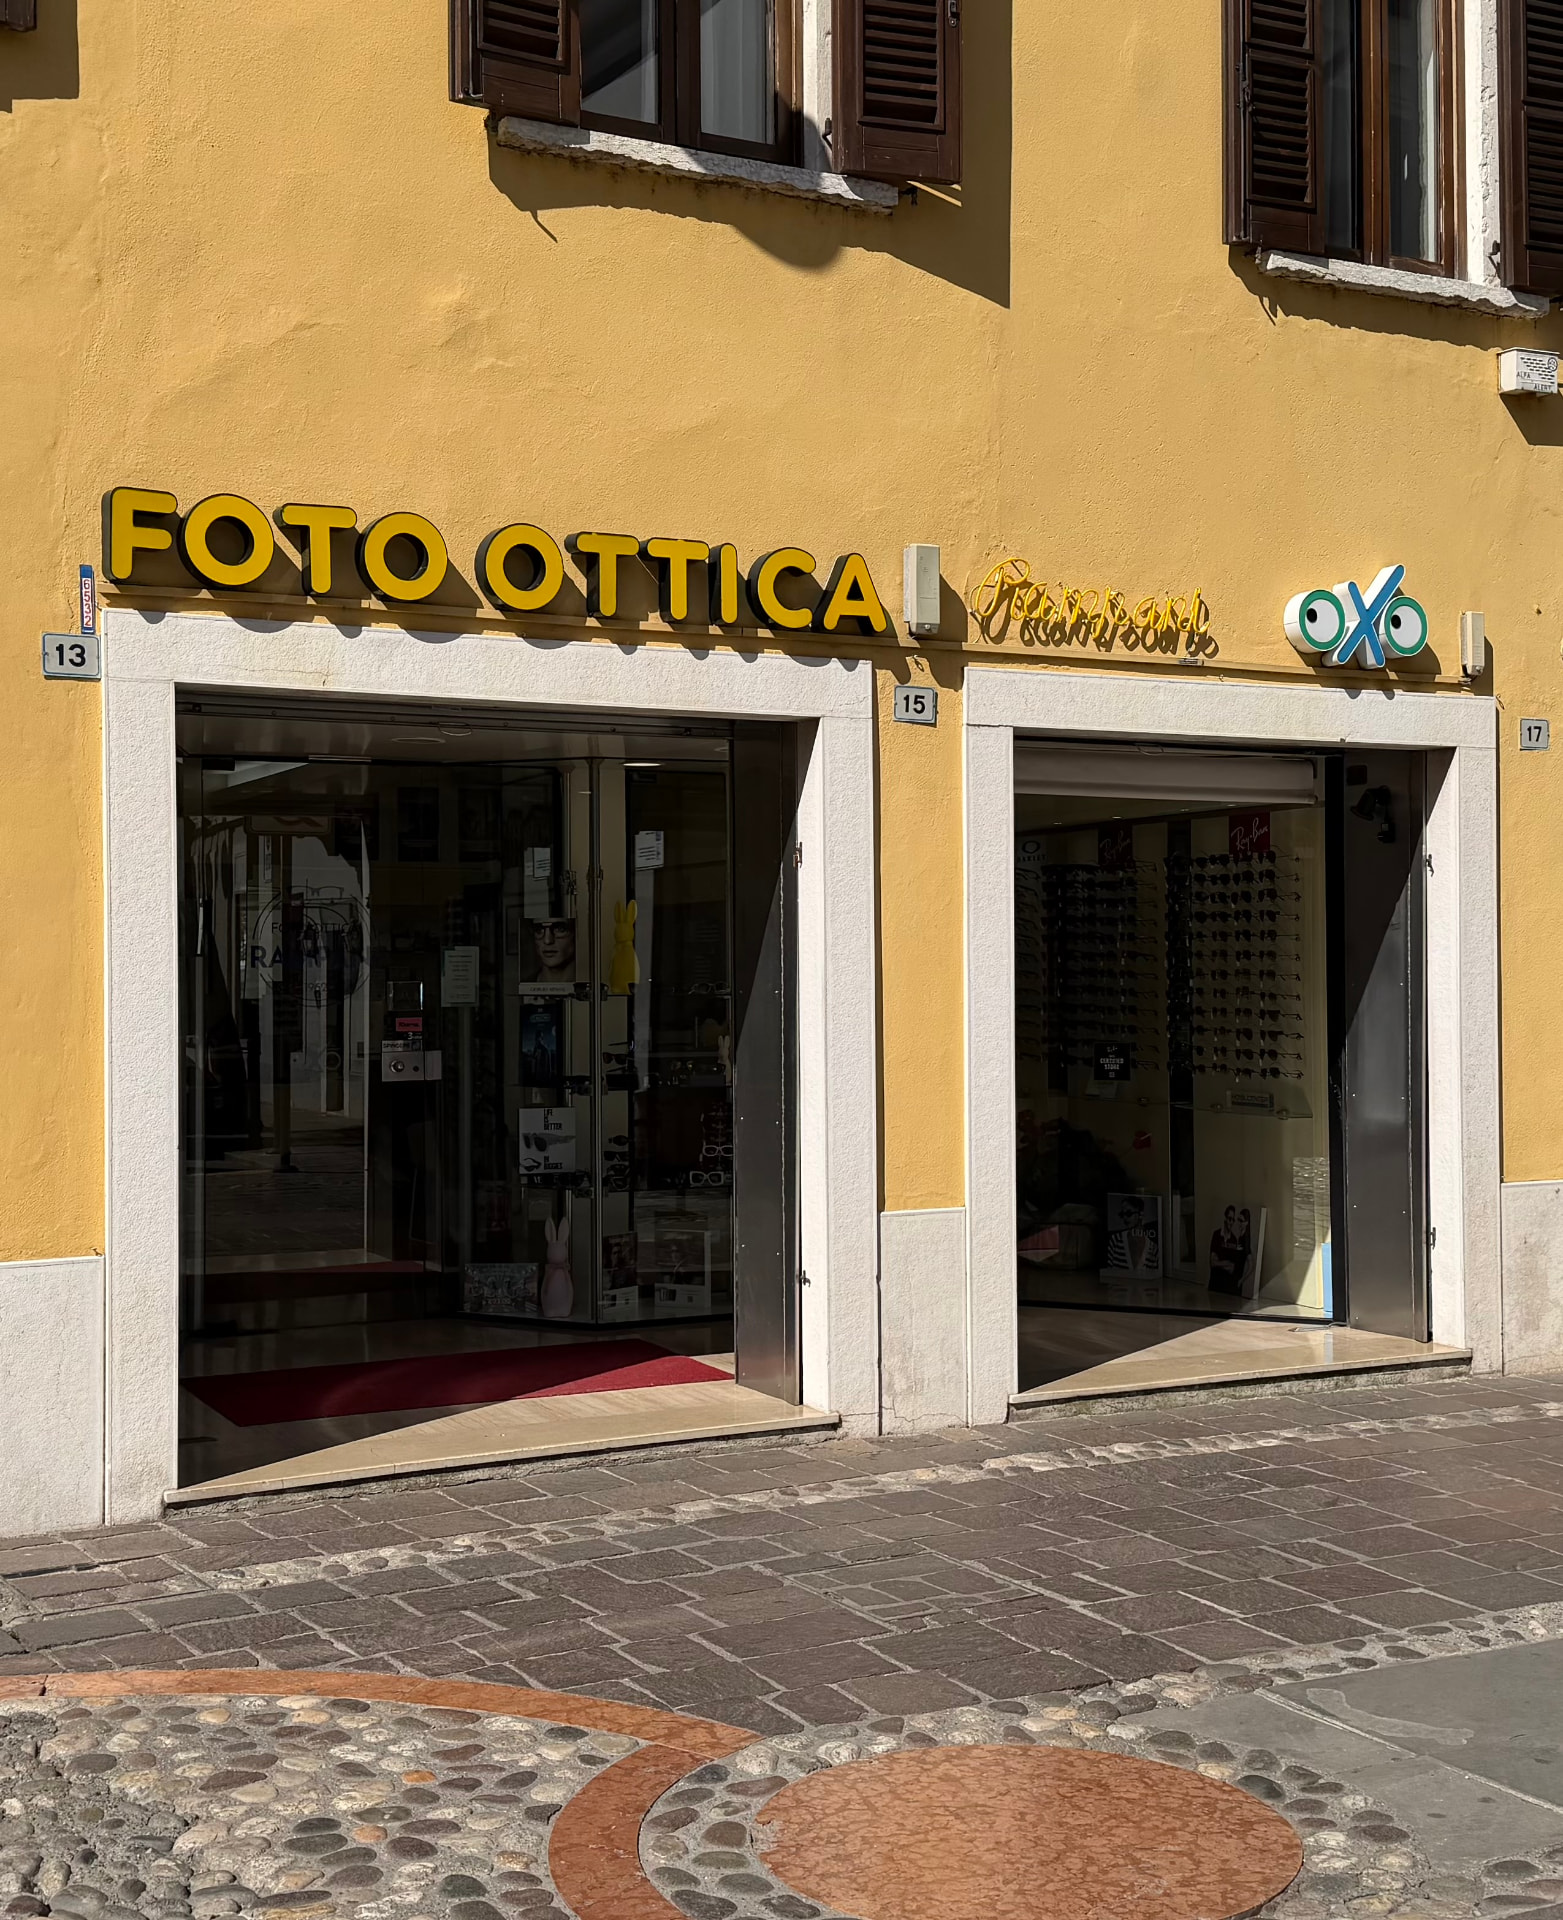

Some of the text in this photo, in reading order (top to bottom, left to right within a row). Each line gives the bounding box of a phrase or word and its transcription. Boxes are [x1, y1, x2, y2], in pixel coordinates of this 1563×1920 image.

[102, 486, 890, 633] FOTO OTTICA
[82, 579, 92, 628] 6532
[55, 643, 87, 668] 13
[903, 694, 926, 715] 15
[1526, 725, 1542, 743] 17
